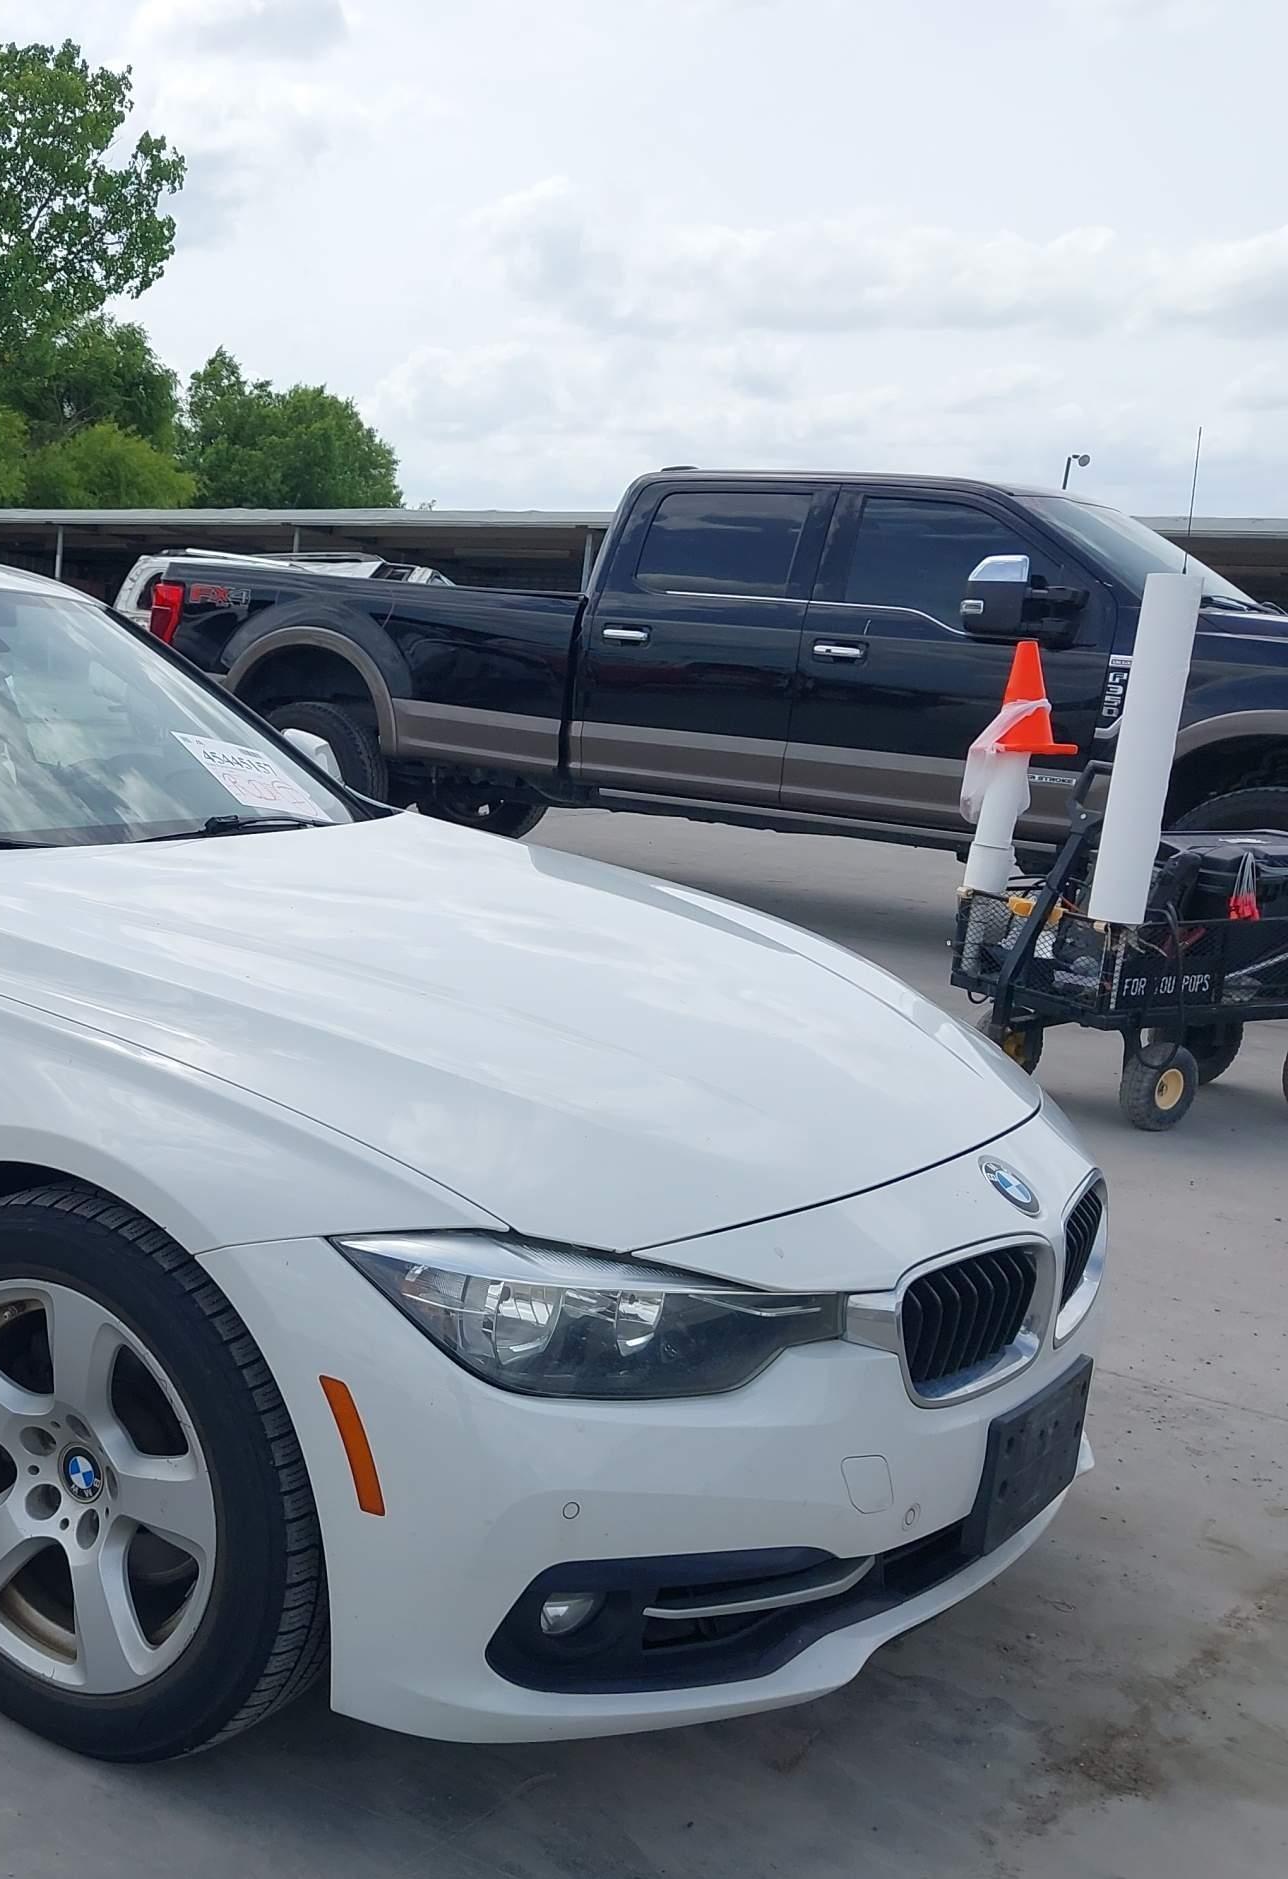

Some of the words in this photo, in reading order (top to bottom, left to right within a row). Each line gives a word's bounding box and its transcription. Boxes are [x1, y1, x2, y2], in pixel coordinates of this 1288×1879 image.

[190, 583, 251, 607] FX4
[202, 749, 278, 777] 45445157
[1123, 977, 1147, 996] FOR
[1181, 974, 1210, 993] POPS
[70, 1478, 101, 1498] BMW
